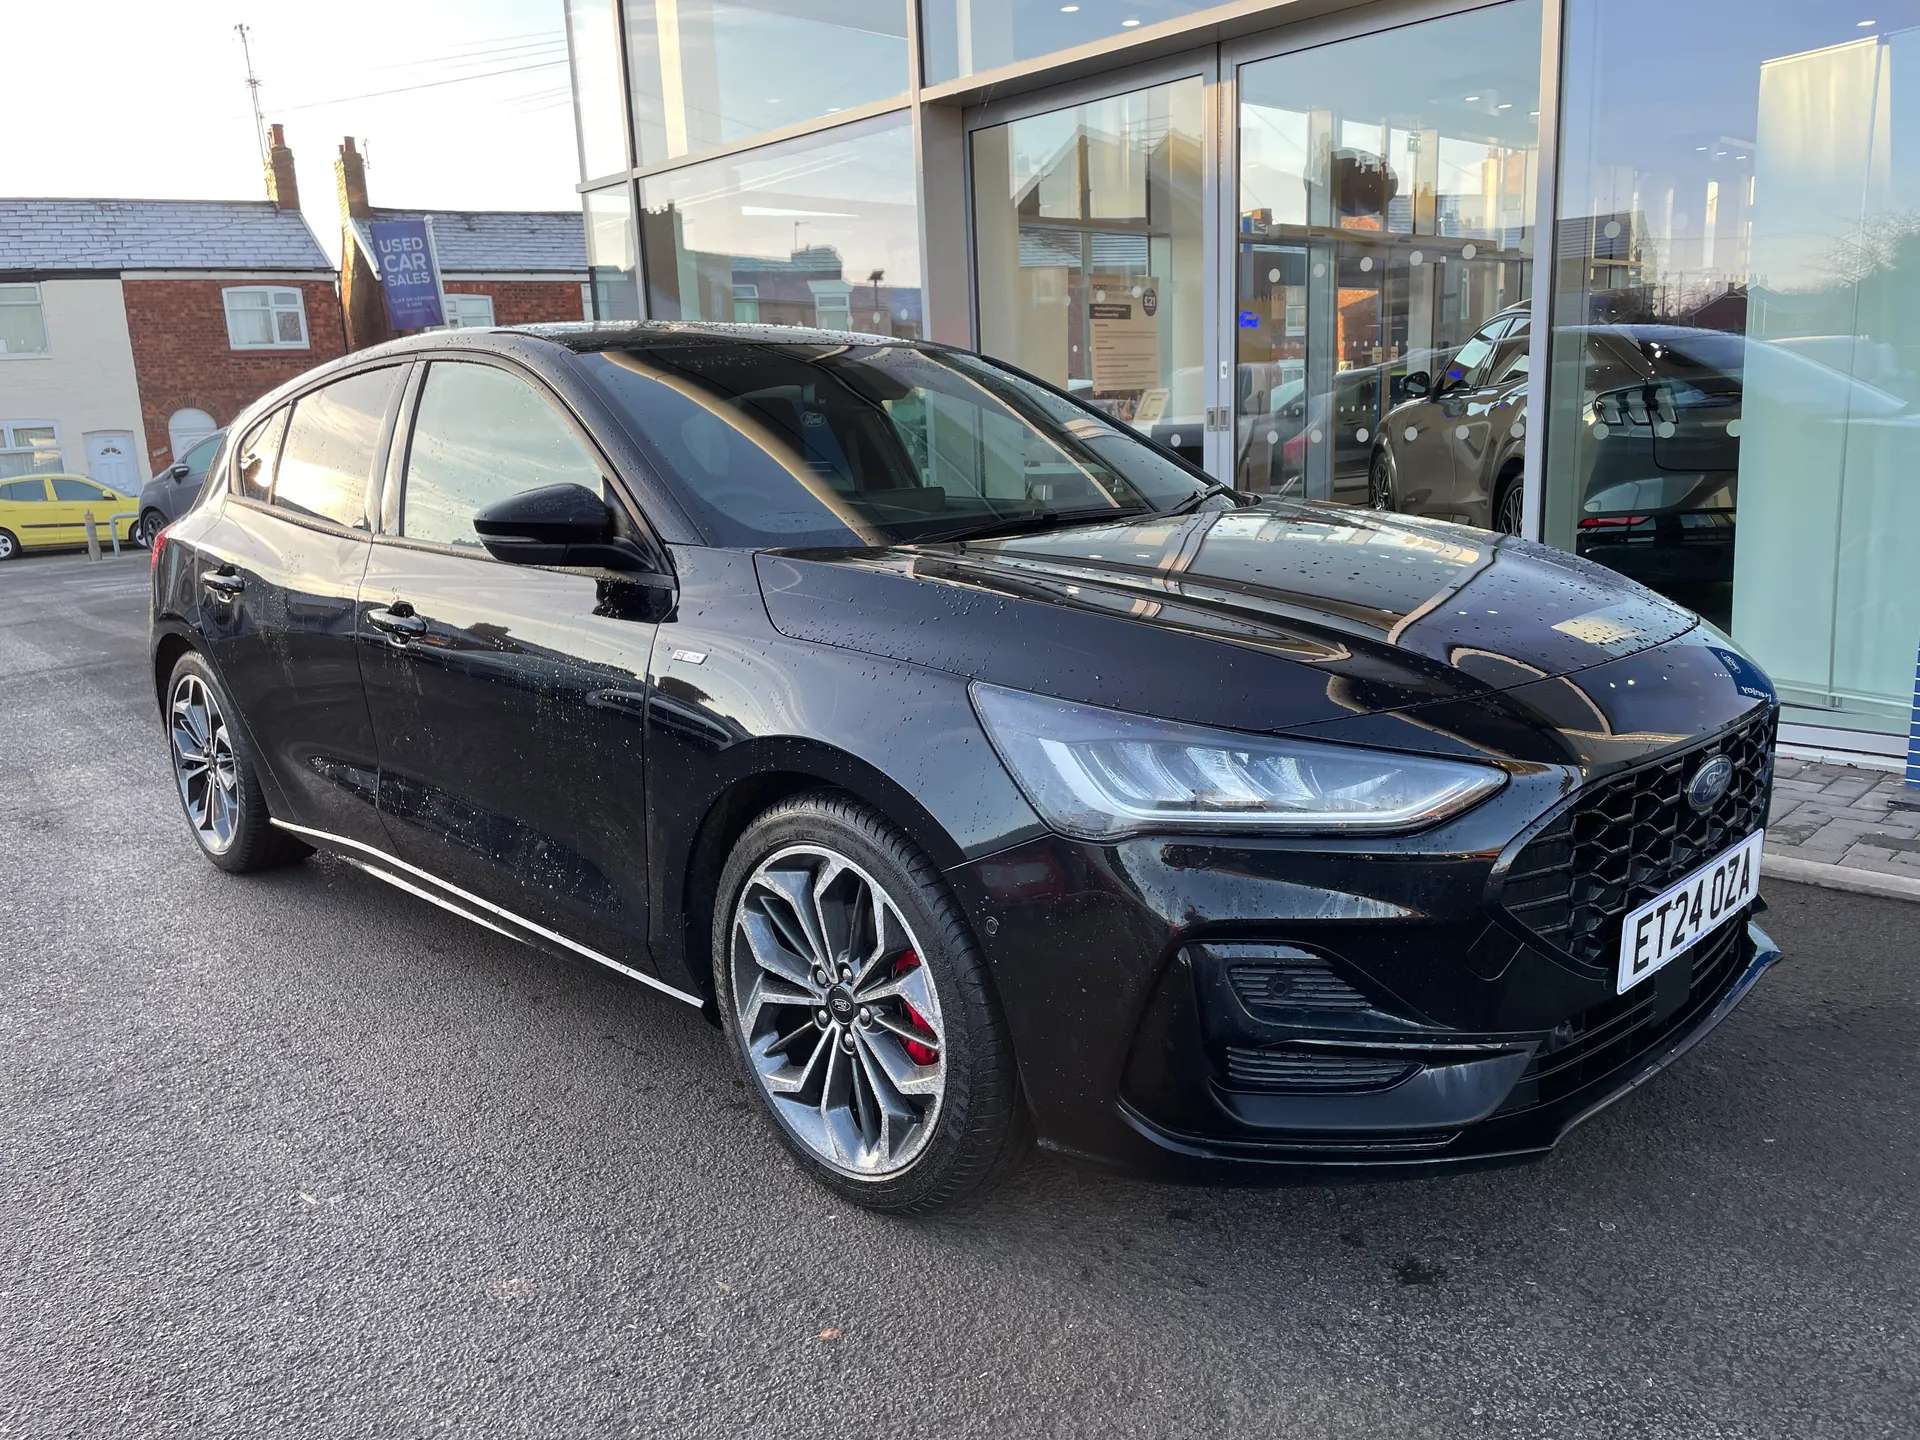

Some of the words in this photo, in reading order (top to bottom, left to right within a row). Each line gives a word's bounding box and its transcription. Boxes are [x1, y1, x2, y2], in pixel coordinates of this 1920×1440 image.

[380, 237, 424, 254] USED
[383, 252, 427, 273] CAR
[387, 271, 431, 287] SALES
[1632, 879, 1704, 976] ET24
[1708, 846, 1752, 920] OZA
